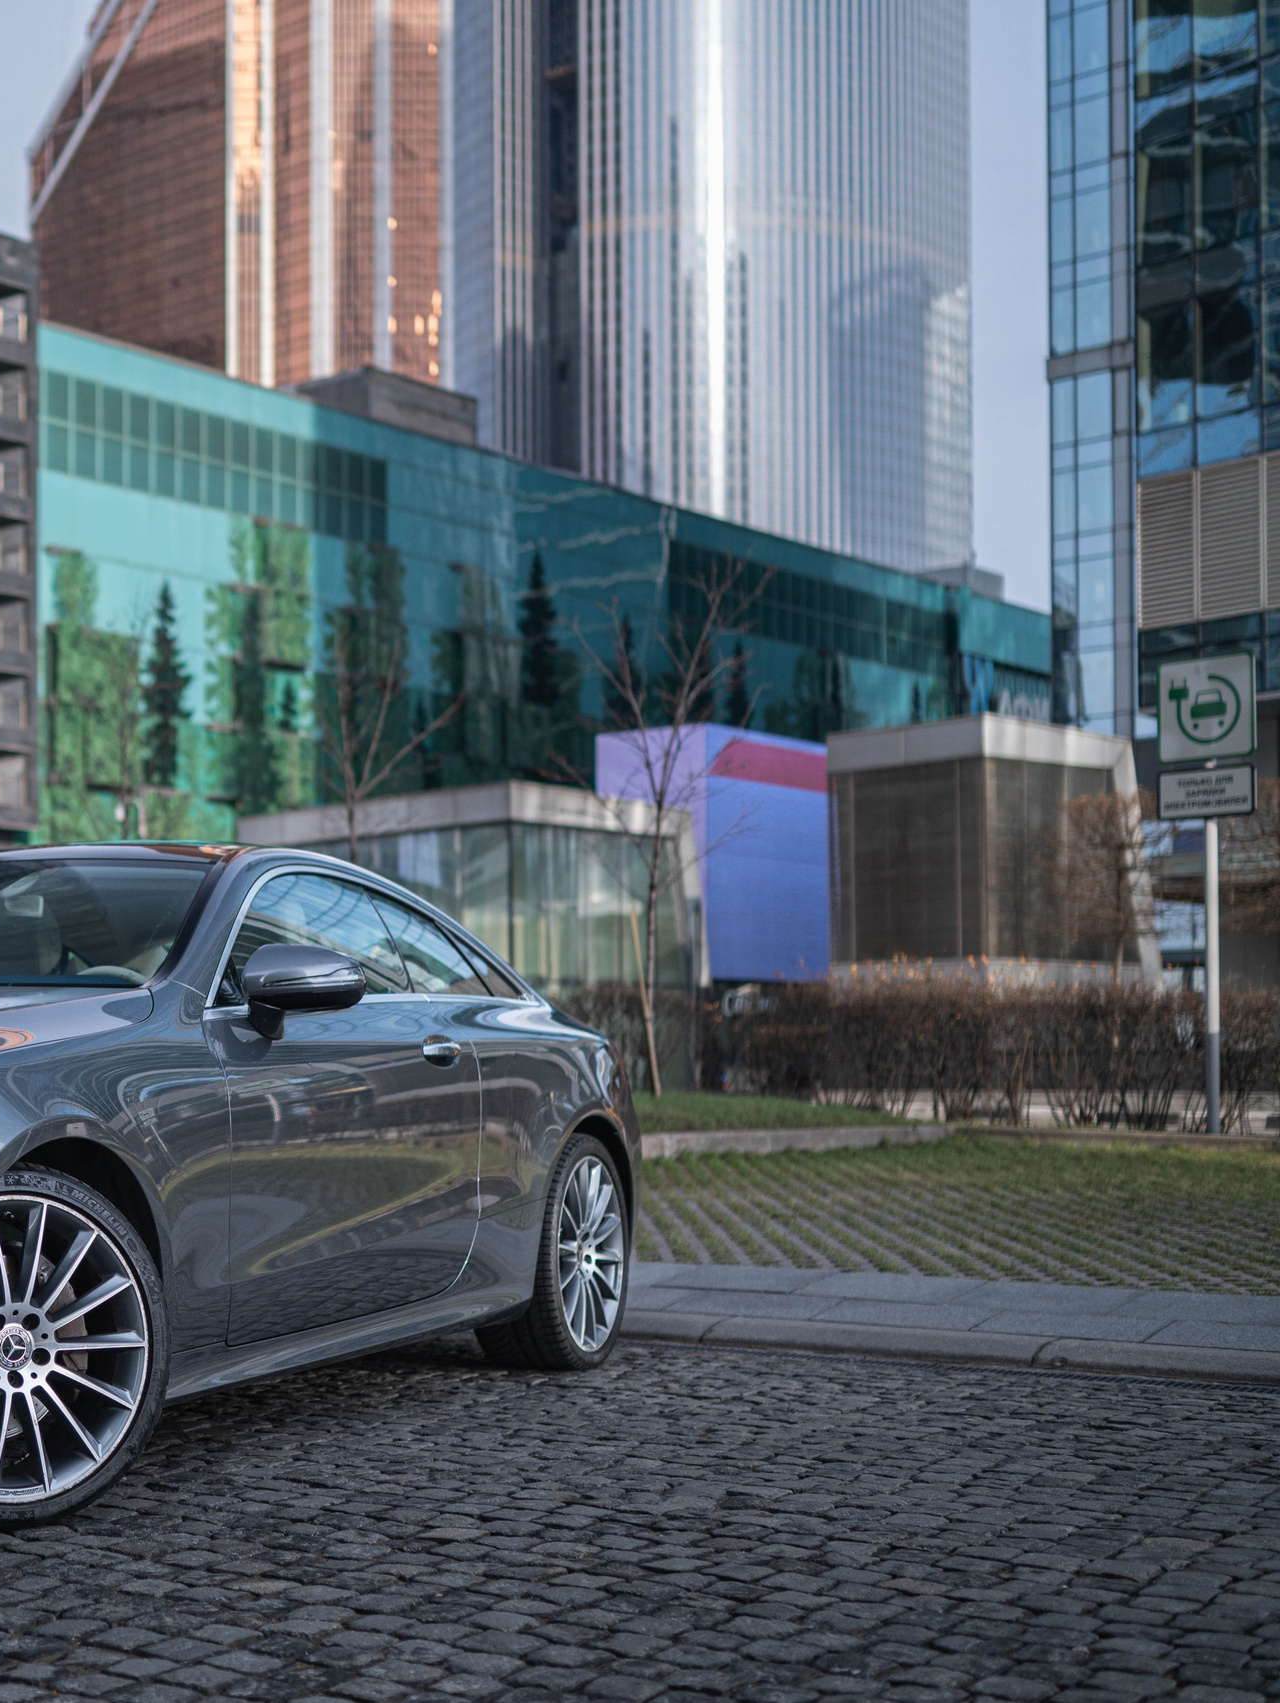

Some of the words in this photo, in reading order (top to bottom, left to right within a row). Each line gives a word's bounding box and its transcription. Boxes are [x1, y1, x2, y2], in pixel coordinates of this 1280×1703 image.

[1178, 777, 1213, 788] ТОЛЬКО
[1215, 775, 1233, 786] ДЛЯ
[1185, 787, 1225, 798] ЗАРЯДКИ
[1164, 796, 1248, 811] ЭЛЕКТРОМОБИЛЕЙ
[70, 1188, 127, 1240] MICHELIN
